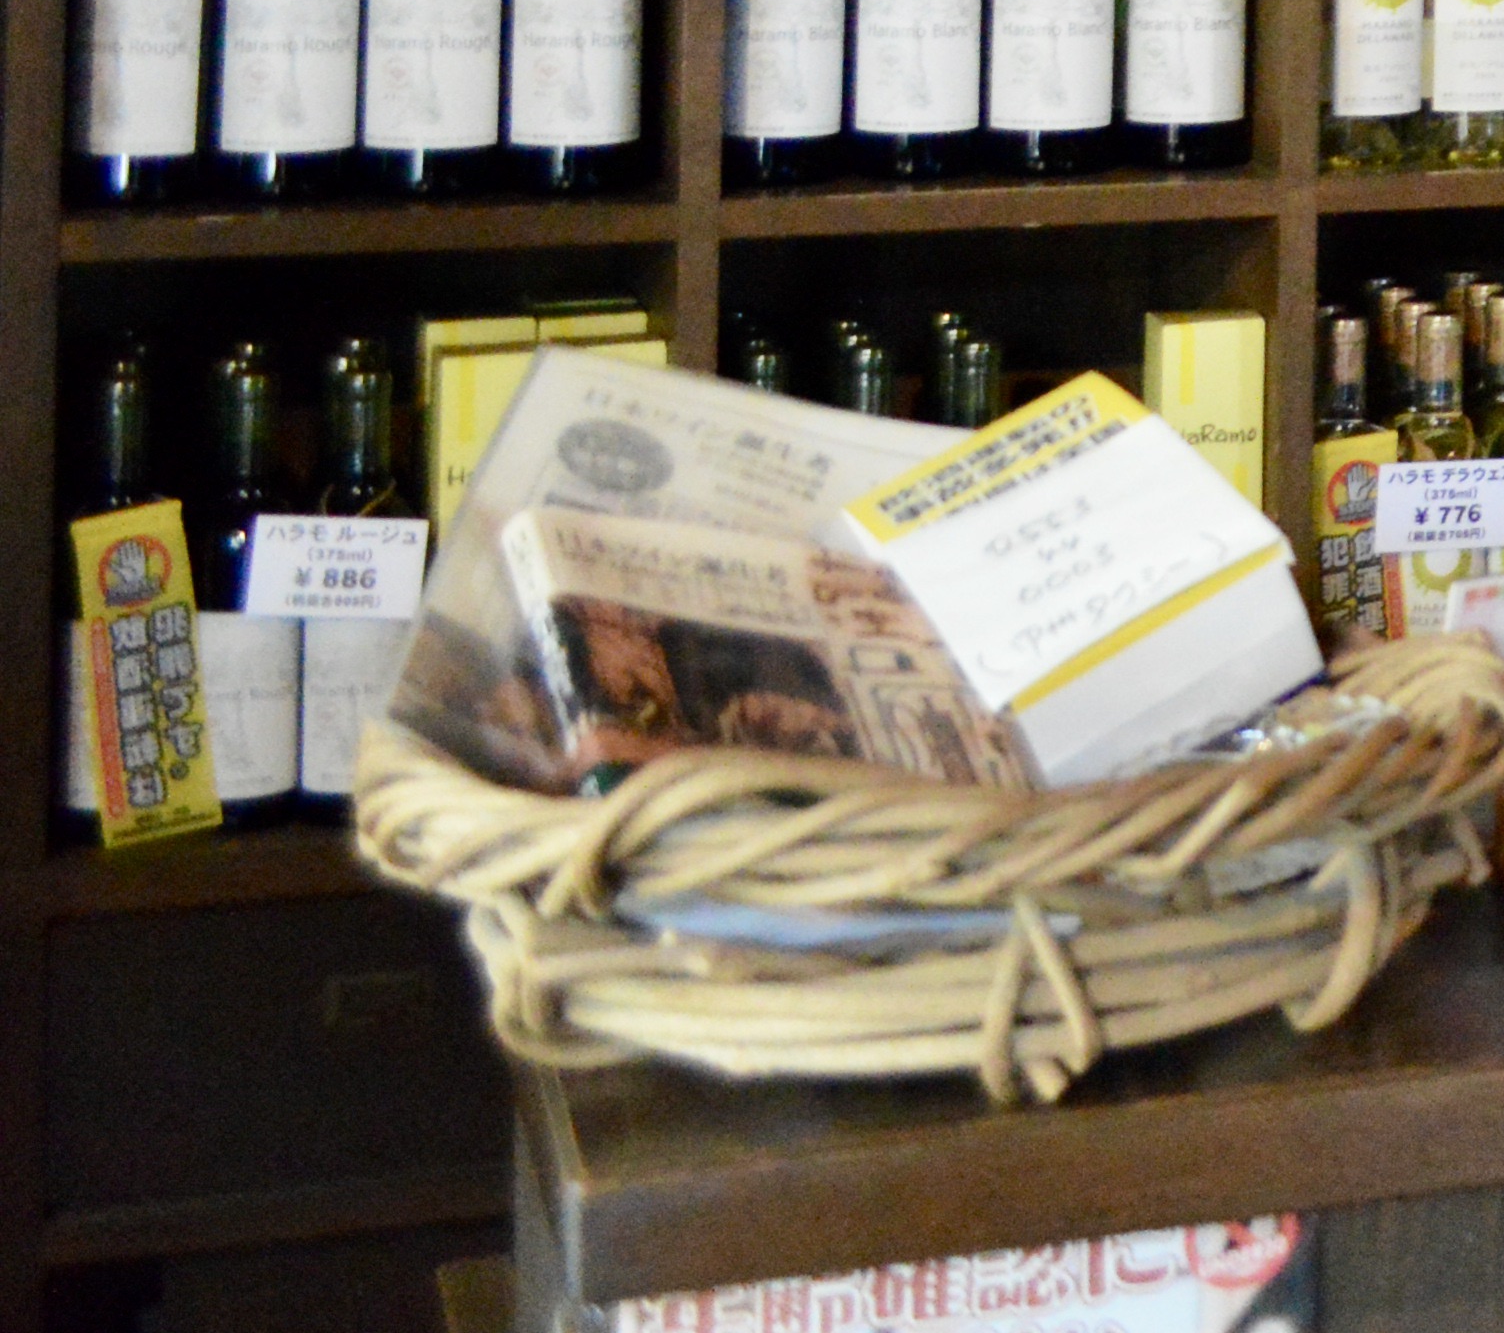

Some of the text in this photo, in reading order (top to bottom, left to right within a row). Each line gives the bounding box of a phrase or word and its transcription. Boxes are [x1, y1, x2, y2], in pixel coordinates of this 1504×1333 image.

[1388, 468, 1436, 485] ハラモ
[1438, 504, 1482, 524] 776
[267, 524, 418, 545] ハラモ ルージュ
[323, 568, 378, 590] 886
